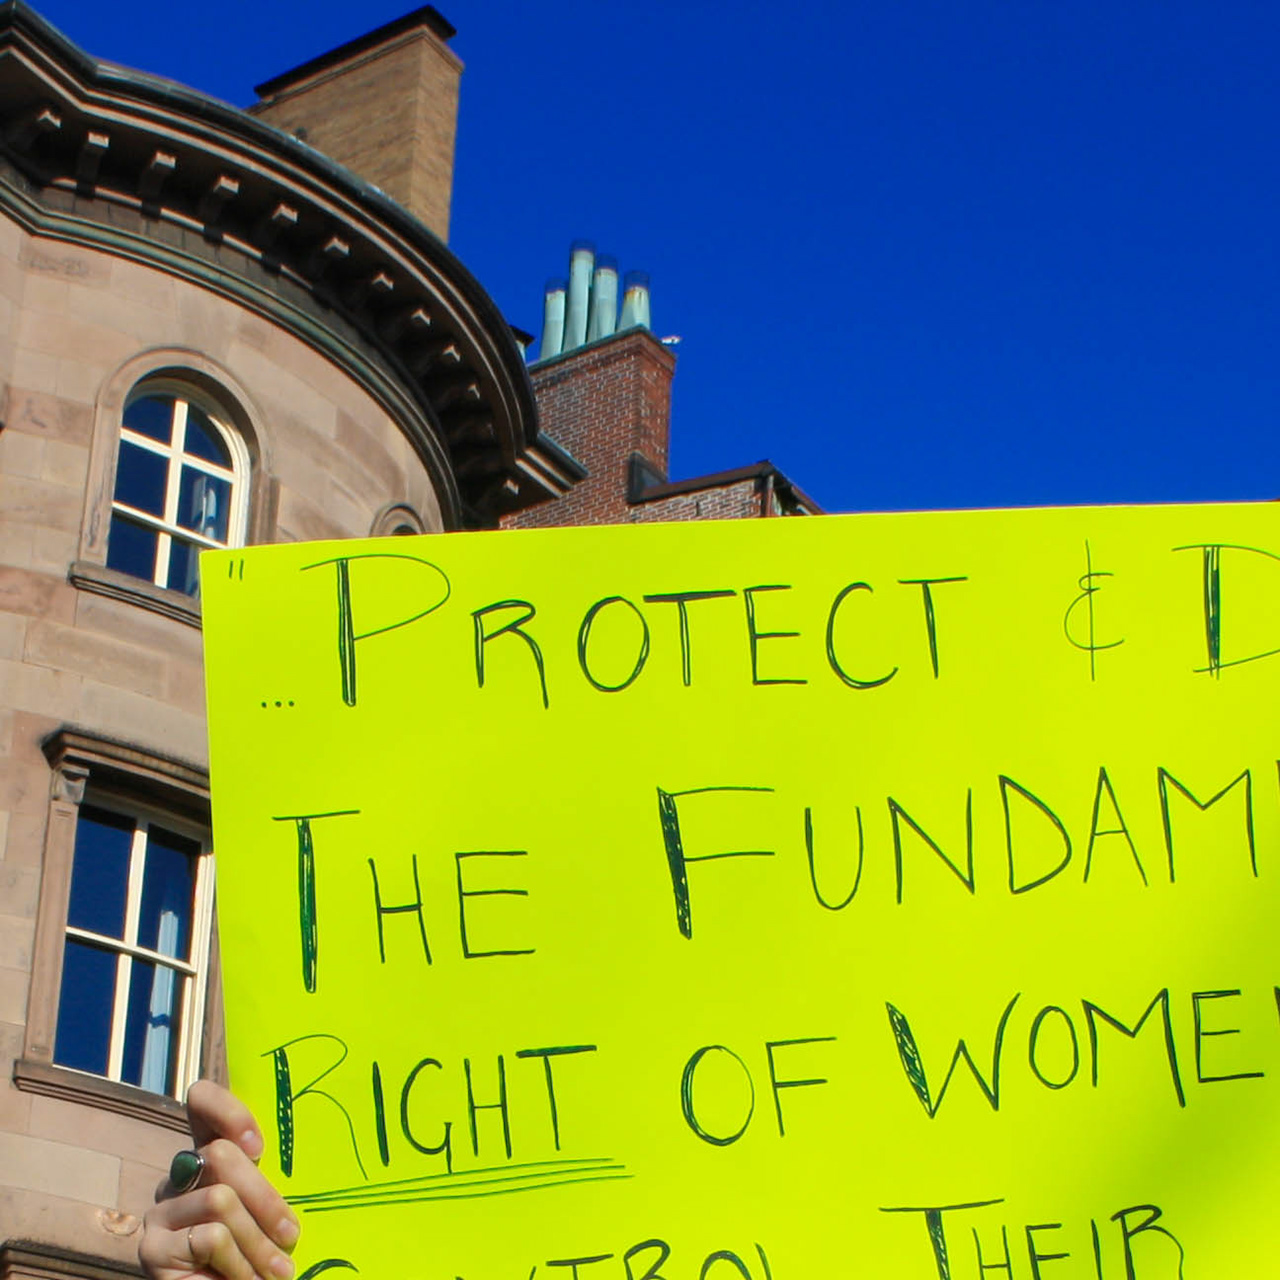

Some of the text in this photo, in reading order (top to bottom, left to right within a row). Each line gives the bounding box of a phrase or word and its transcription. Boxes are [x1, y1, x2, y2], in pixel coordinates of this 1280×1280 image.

[271, 809, 537, 994] THE
[261, 1034, 600, 1182] RIGHT
[679, 1035, 838, 1148] OF
